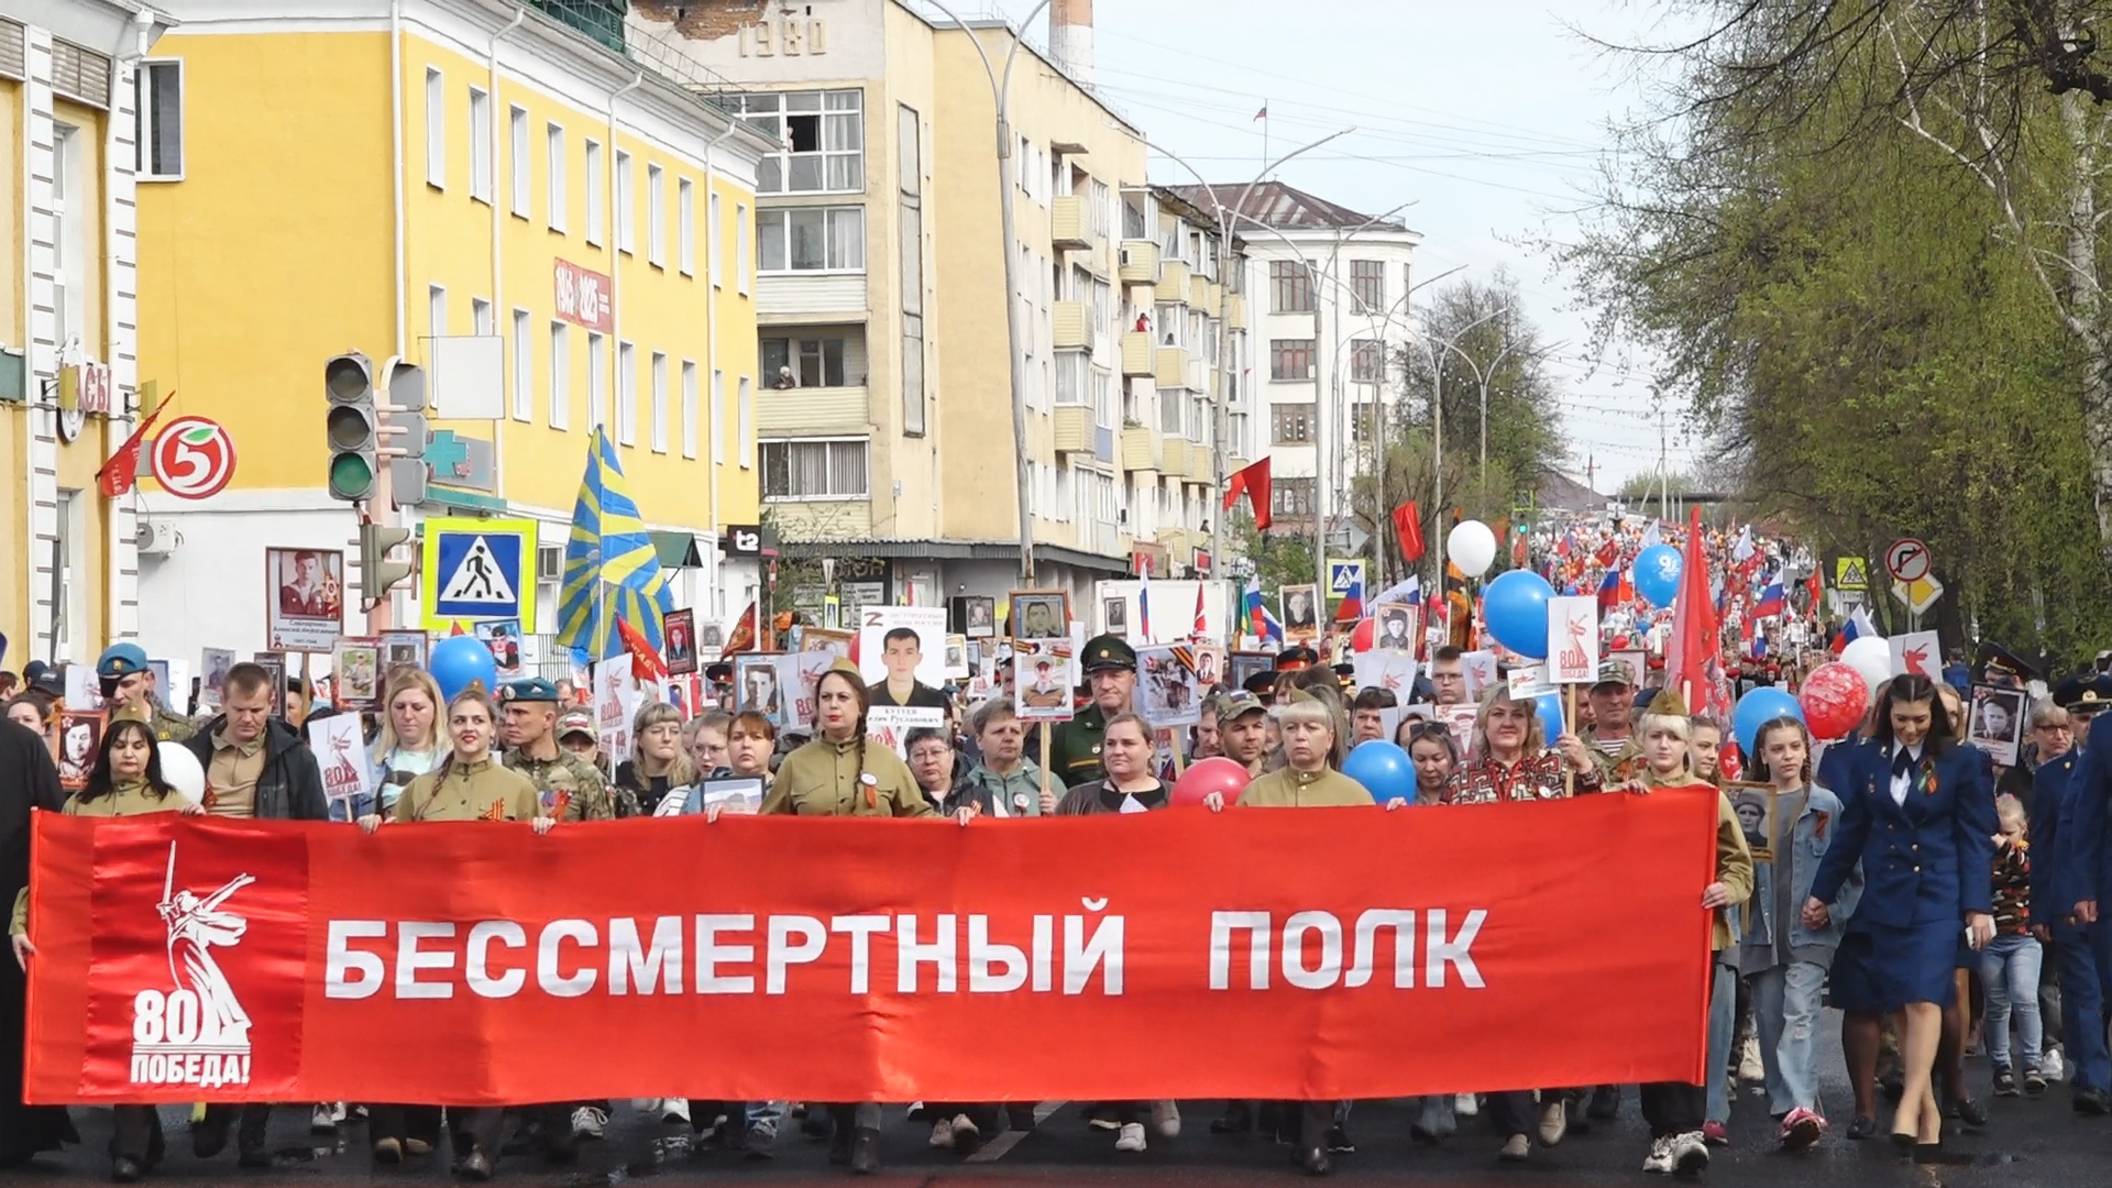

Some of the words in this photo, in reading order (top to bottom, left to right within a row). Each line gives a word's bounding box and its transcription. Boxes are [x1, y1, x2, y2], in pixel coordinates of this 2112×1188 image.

[740, 20, 827, 57] 1980
[325, 897, 1124, 999] БЕССМЕРТНЫЙ
[1208, 908, 1488, 990] ПОЛК
[134, 989, 200, 1044] 80
[130, 1055, 251, 1088] ПОБЕДА!
